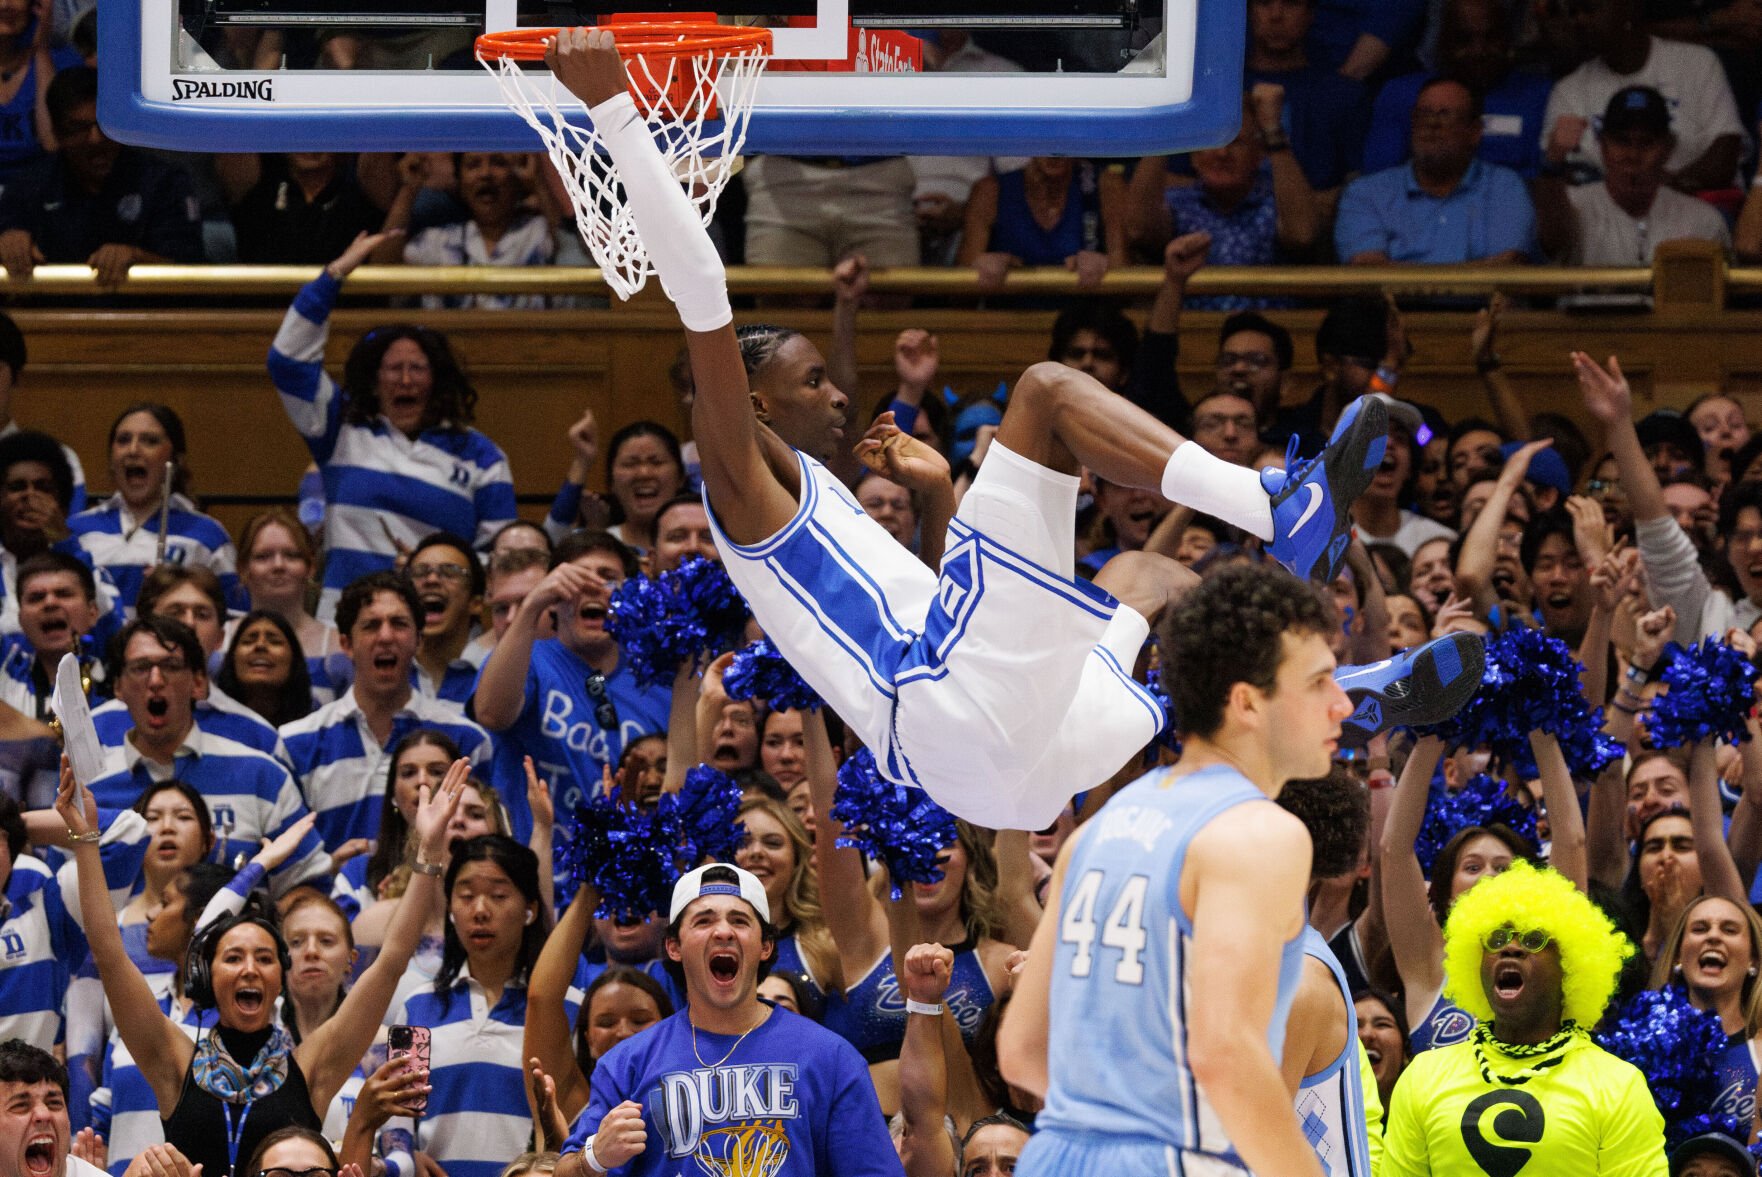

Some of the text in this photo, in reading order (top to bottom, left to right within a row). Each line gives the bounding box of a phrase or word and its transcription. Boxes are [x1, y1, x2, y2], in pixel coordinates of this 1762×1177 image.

[172, 79, 273, 102] SPALDING
[1061, 867, 1150, 987] 44
[660, 1062, 800, 1159] DUKE
